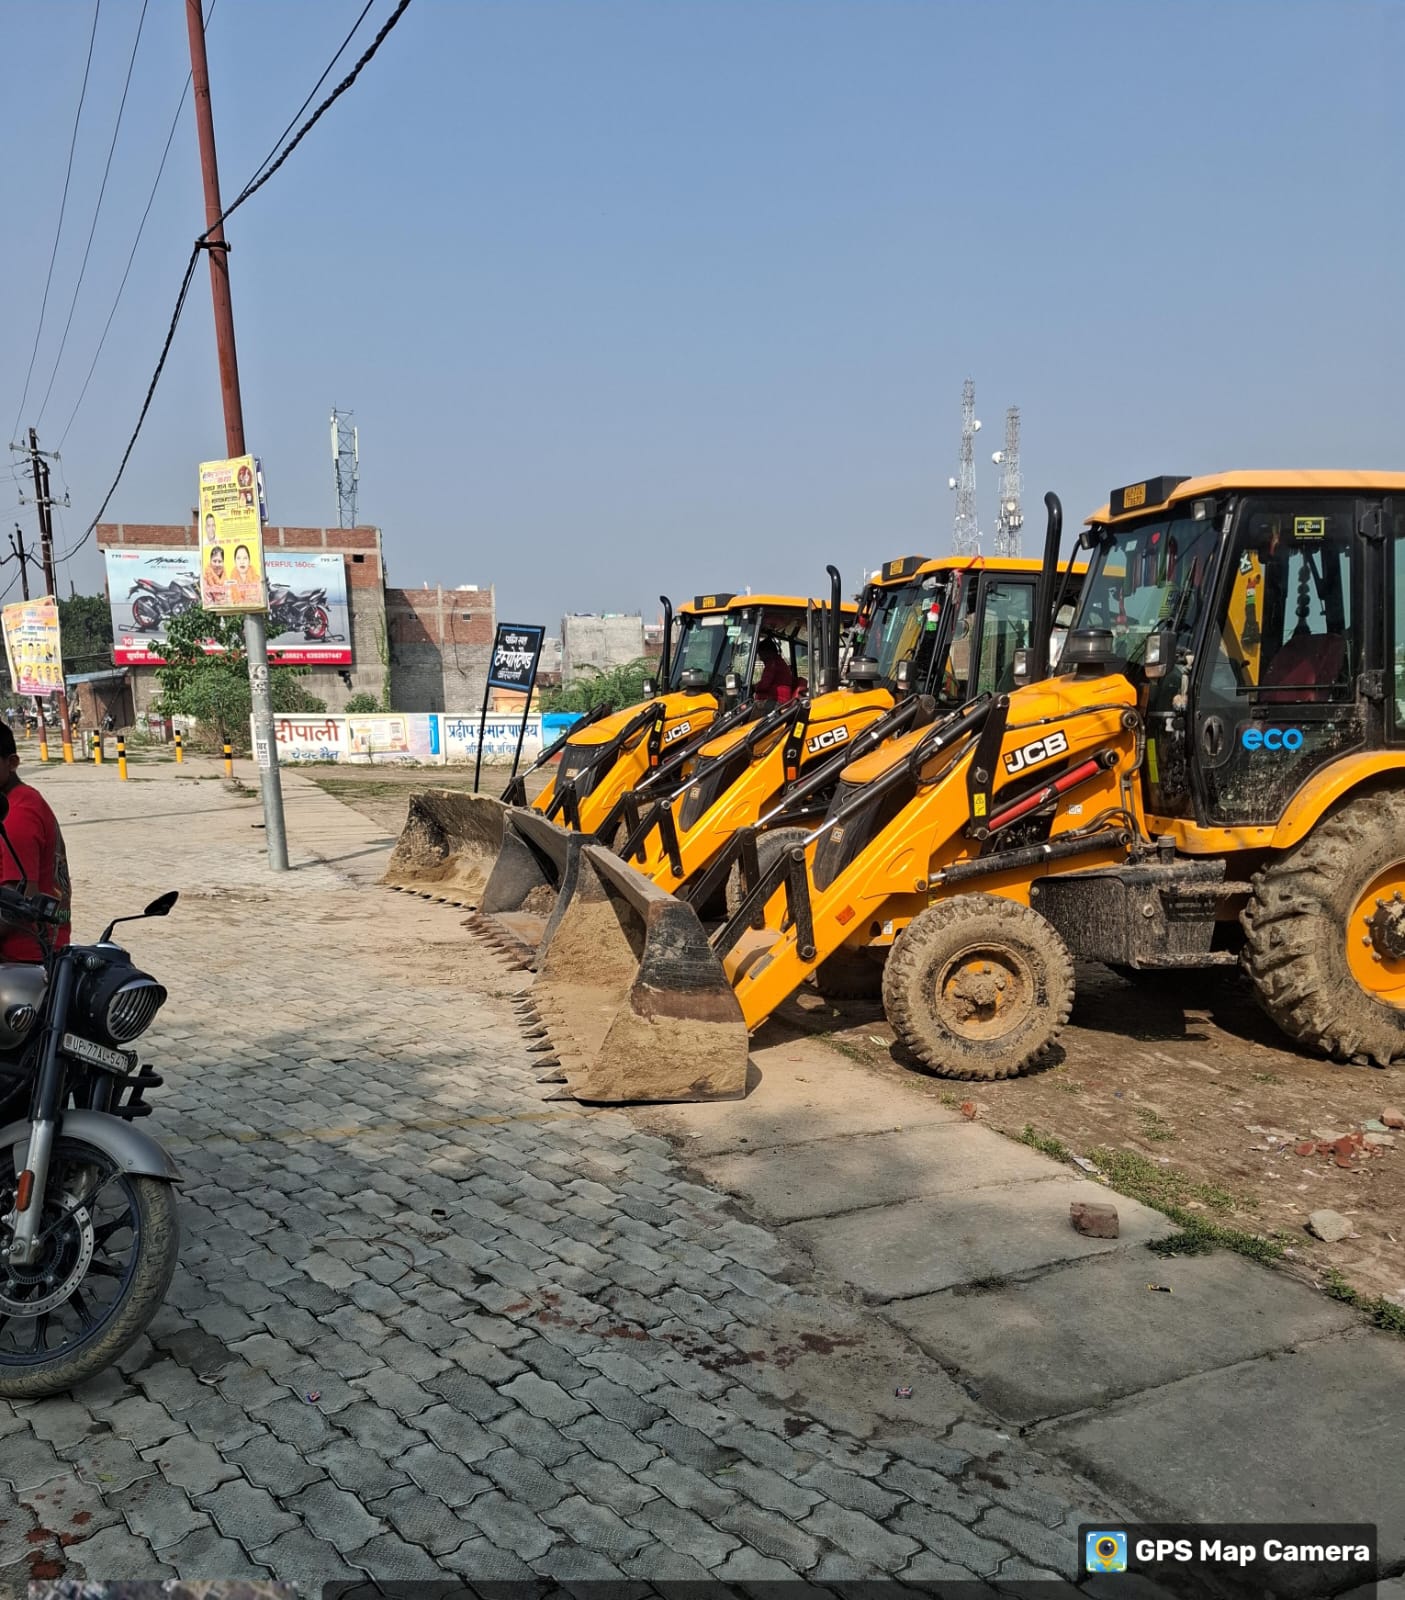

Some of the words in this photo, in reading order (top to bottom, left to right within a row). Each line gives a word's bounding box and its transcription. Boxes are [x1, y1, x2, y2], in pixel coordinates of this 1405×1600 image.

[447, 720, 476, 741] प्रदीप
[665, 721, 690, 743] JCB
[808, 726, 848, 753] JCB
[1242, 728, 1303, 750] eco
[1005, 732, 1068, 773] JCB
